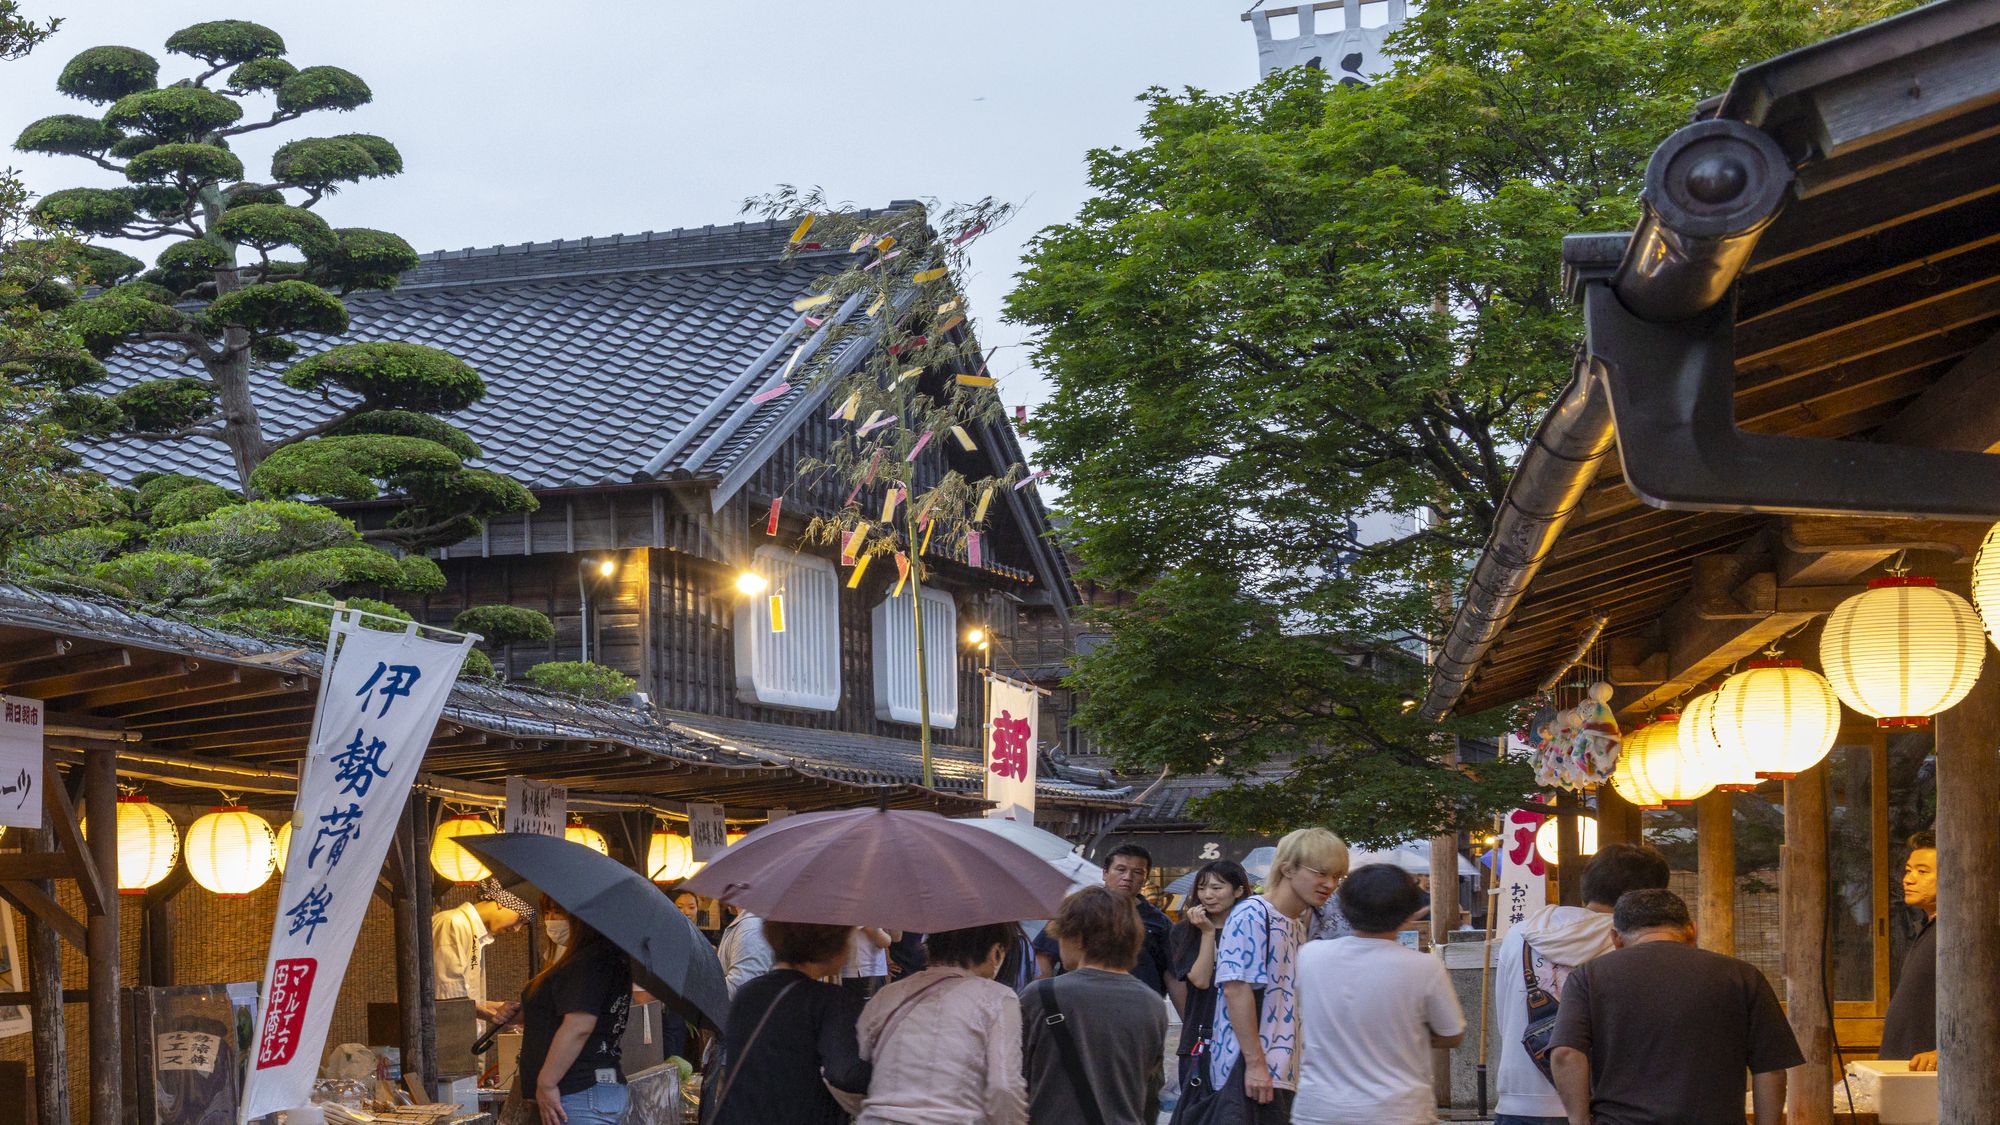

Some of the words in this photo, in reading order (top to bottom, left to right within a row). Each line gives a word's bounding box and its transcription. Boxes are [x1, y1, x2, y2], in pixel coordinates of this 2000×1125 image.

[0, 767, 32, 810] ーツ
[286, 661, 422, 946] 伊勢蒲鉾
[1509, 882, 1529, 928] おかげ横
[259, 964, 290, 1063] 田中商店
